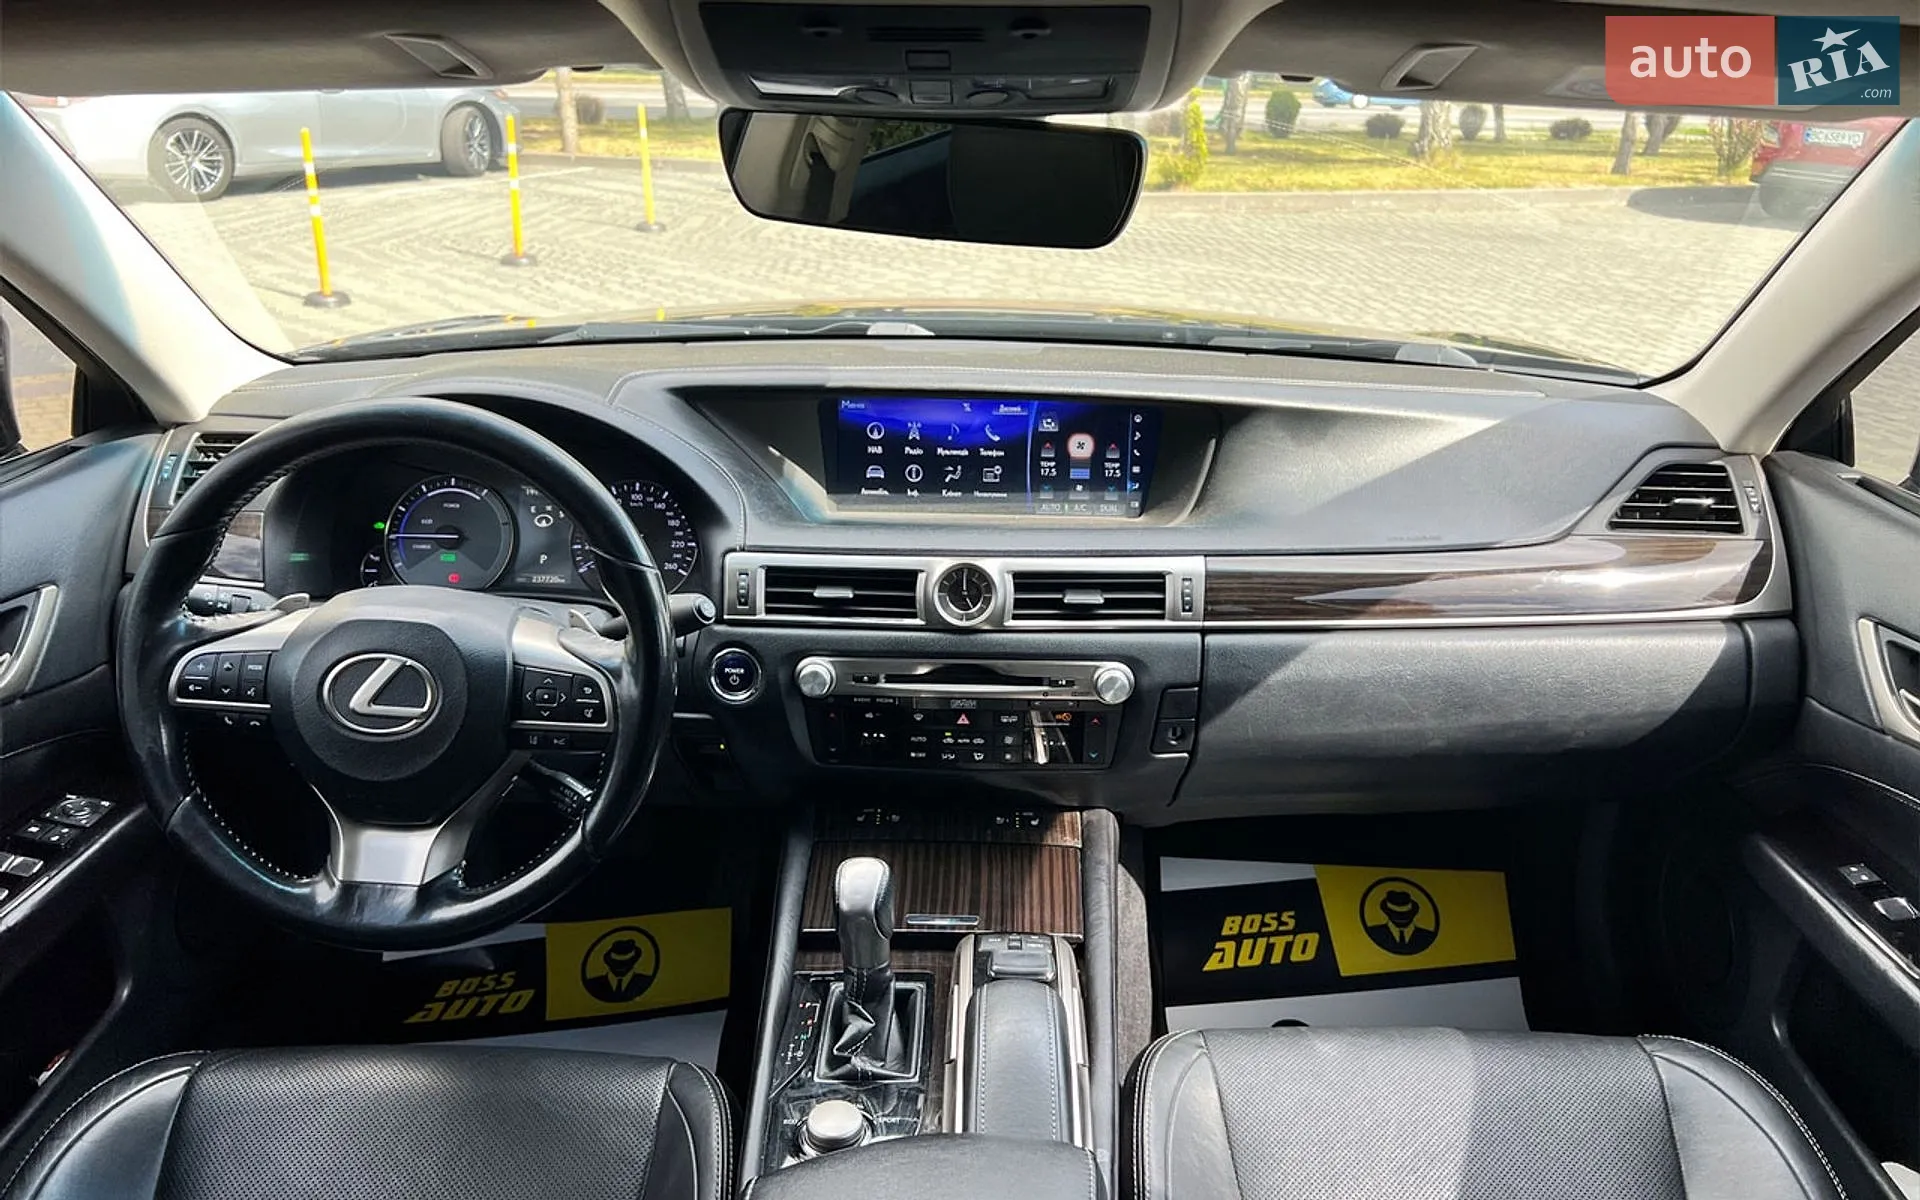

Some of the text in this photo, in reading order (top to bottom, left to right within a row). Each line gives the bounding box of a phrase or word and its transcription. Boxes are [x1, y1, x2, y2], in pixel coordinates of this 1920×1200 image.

[1040, 468, 1057, 477] 17.5
[1104, 469, 1122, 478] 17.5
[630, 493, 643, 501] 100
[667, 519, 681, 527] 180
[540, 554, 548, 564] P
[664, 562, 678, 570] 260
[1221, 910, 1296, 936] BOSS
[1202, 932, 1320, 972] AUTO
[434, 970, 516, 998] BOSS
[403, 989, 535, 1024] AUTO
